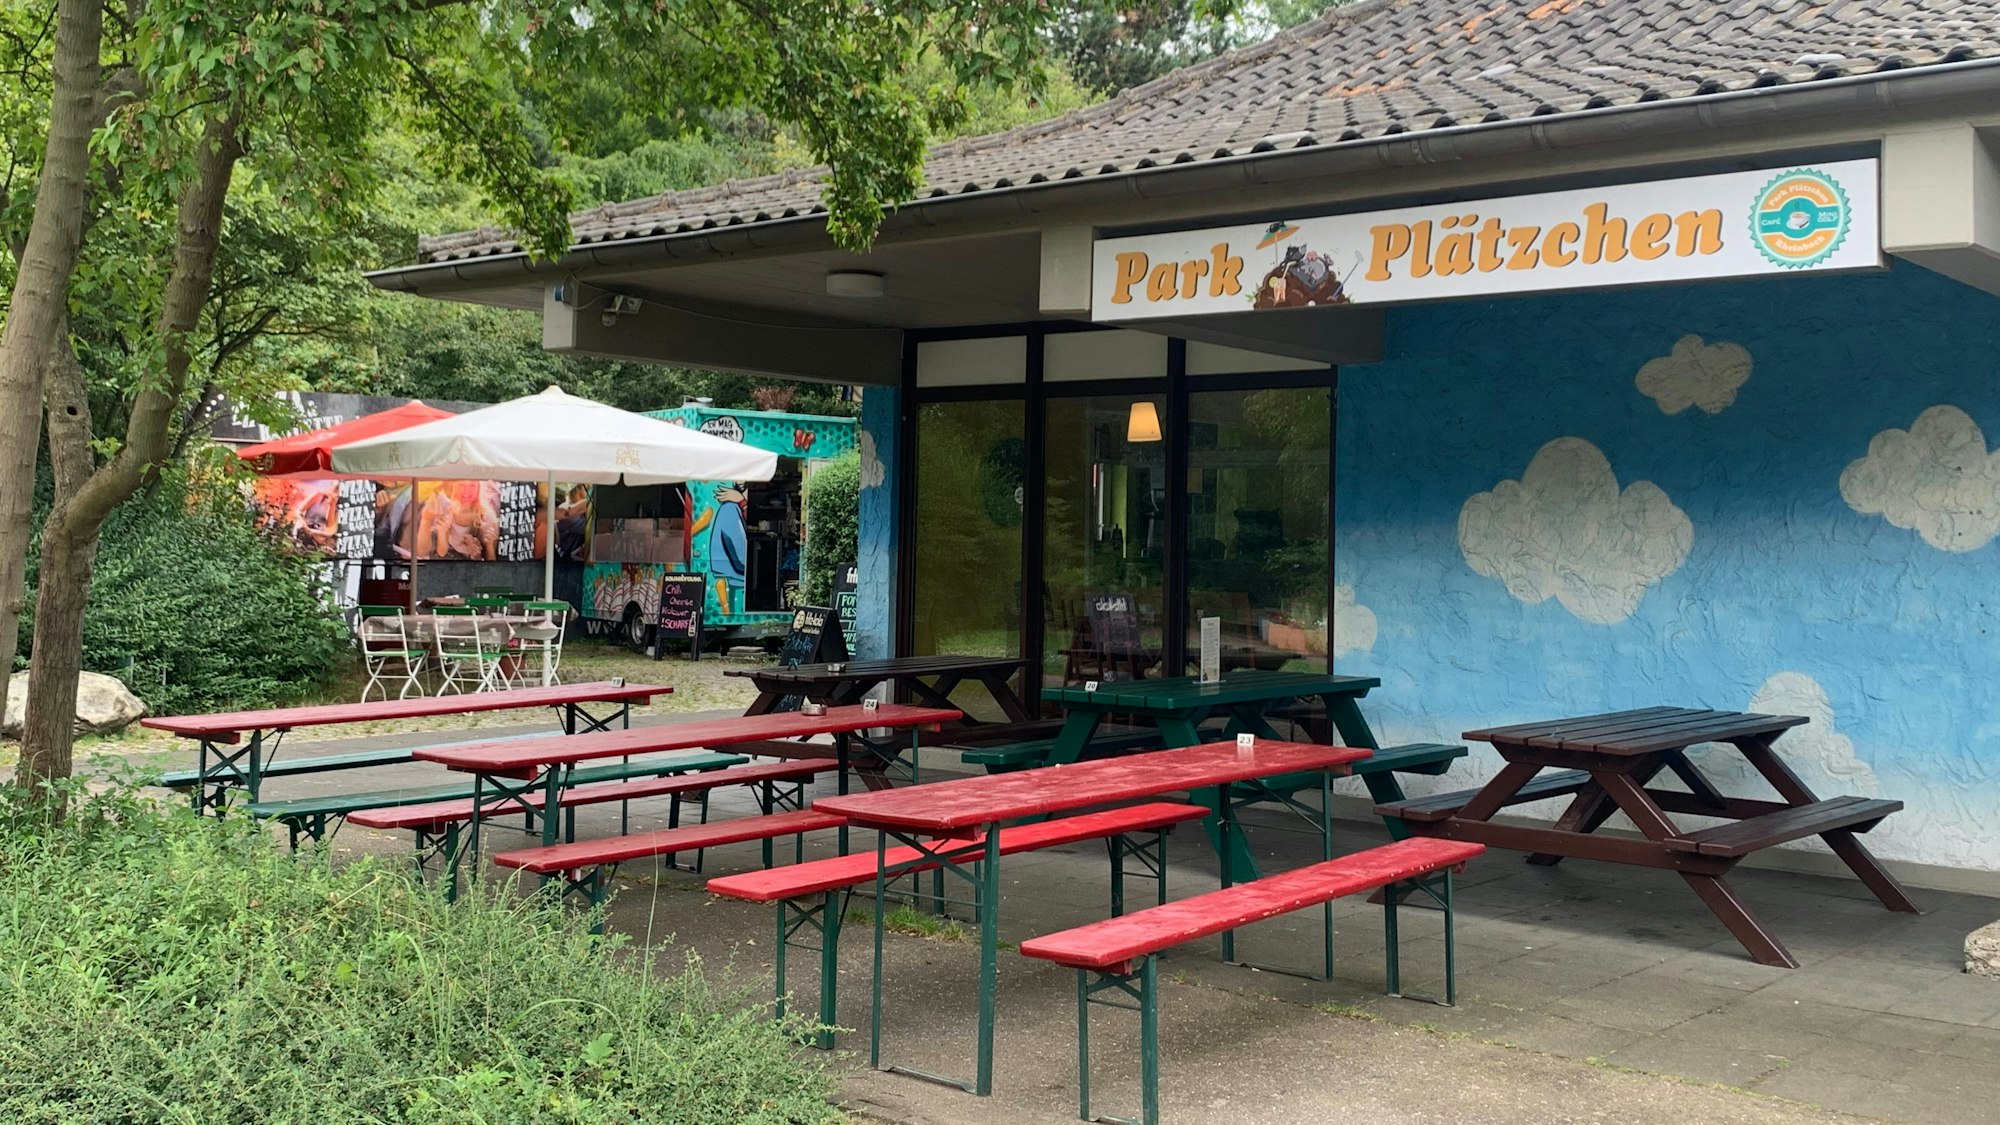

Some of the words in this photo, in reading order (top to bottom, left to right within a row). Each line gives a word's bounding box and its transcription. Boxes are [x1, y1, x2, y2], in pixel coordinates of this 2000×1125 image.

[1768, 188, 1788, 207] Park
[1789, 184, 1828, 203] Plätzchen
[1761, 217, 1781, 226] CAFÉ
[1818, 215, 1838, 223] GOLF
[1775, 236, 1825, 252] Rheinbach
[1111, 242, 1244, 304] Park
[1365, 202, 1724, 282] Plätzchen
[865, 700, 875, 708] 24
[1239, 736, 1251, 744] 23
